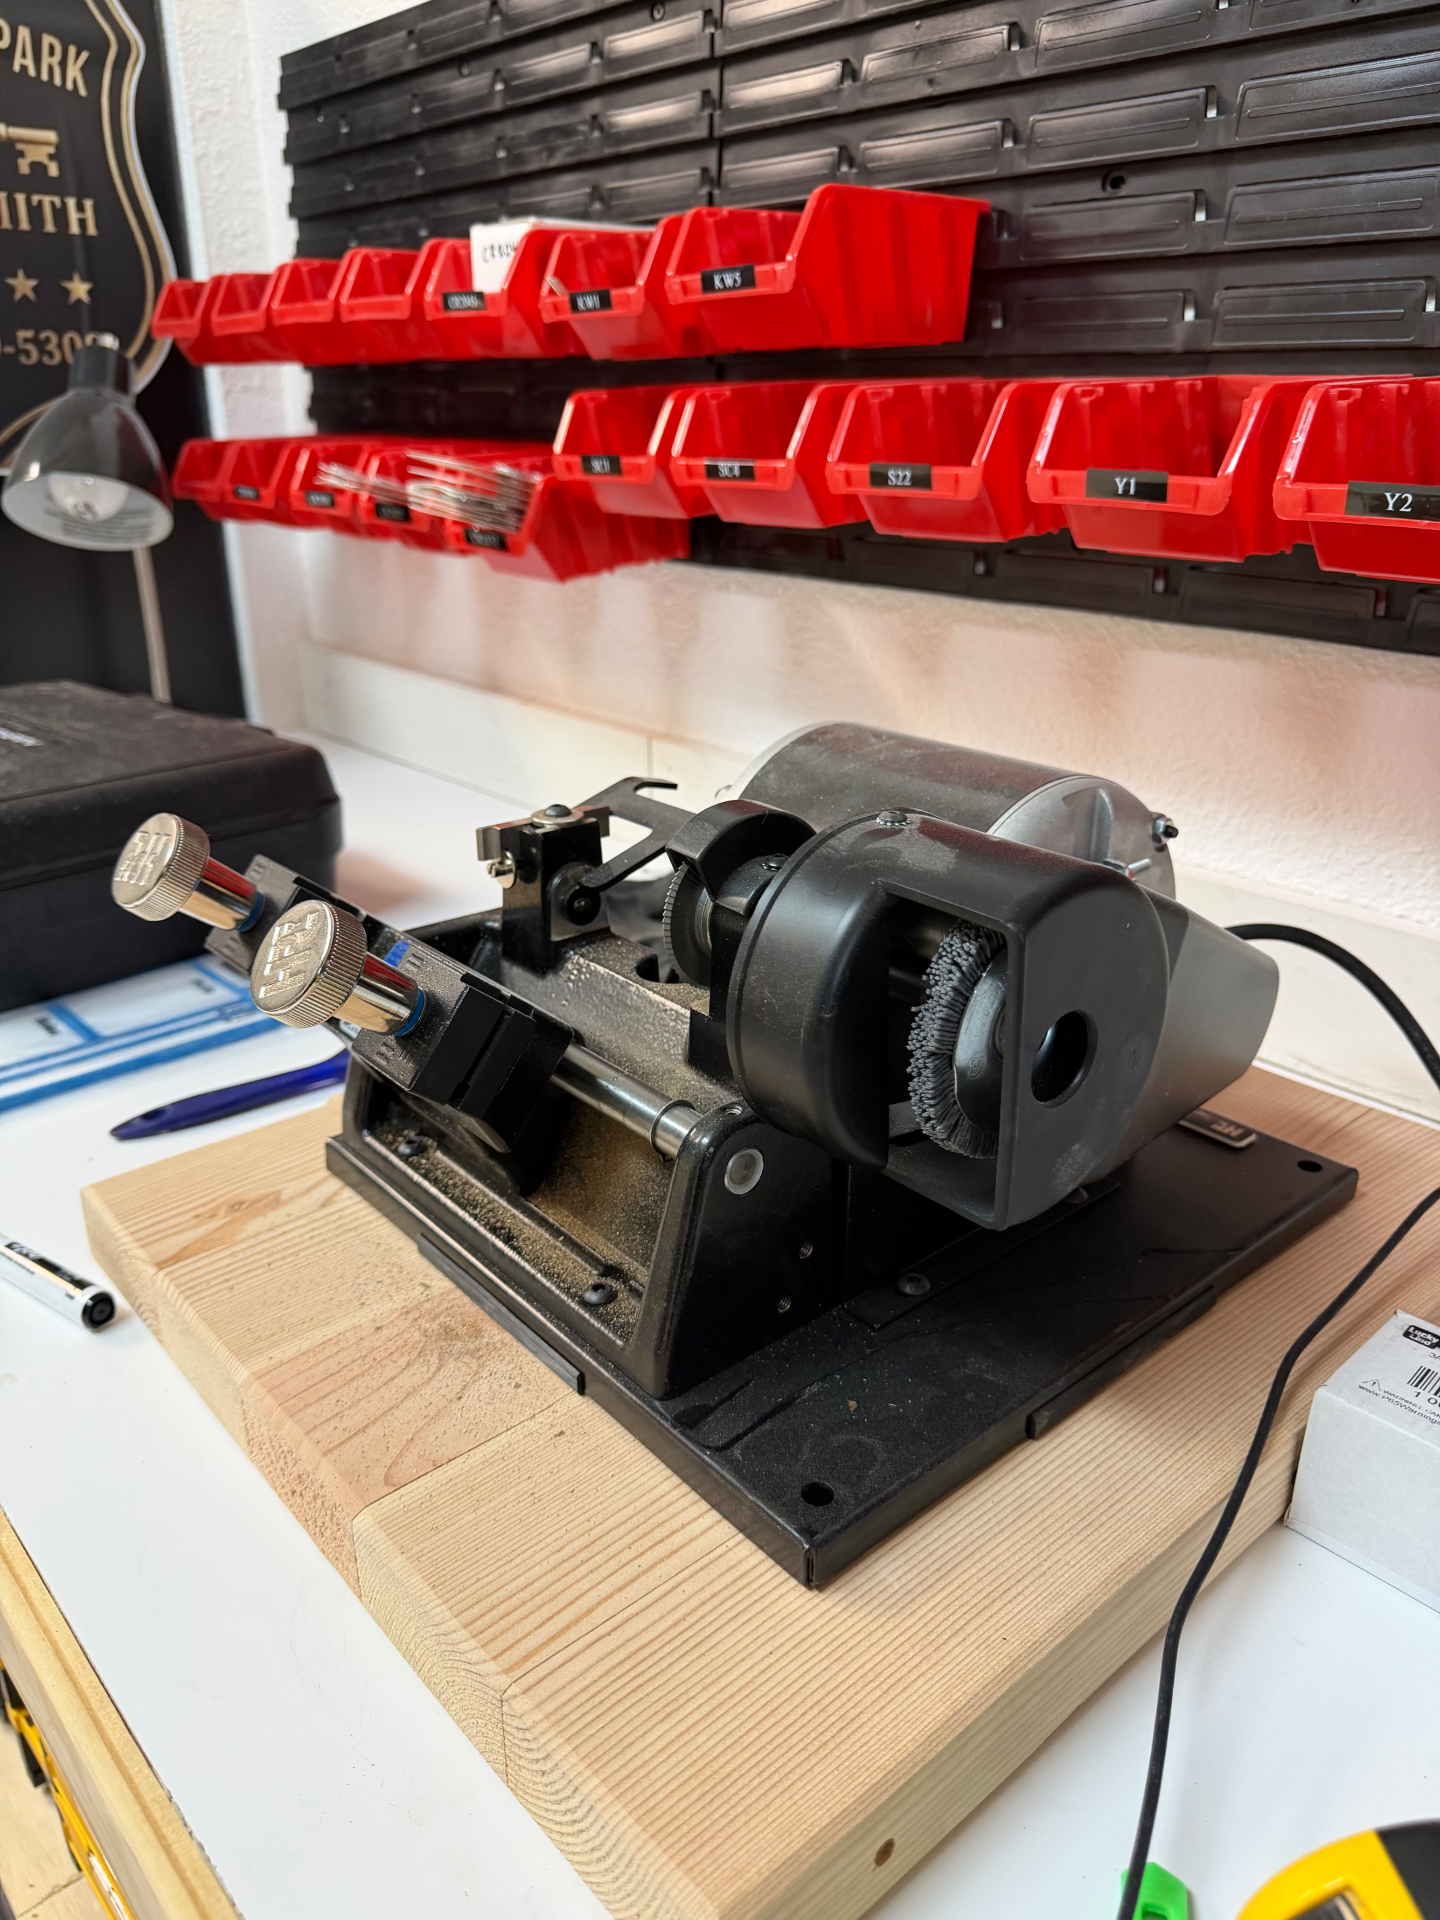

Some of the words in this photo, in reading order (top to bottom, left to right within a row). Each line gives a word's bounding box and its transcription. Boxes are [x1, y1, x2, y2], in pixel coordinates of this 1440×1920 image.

[713, 270, 742, 290] KW5
[886, 468, 912, 487] S22
[1114, 476, 1137, 495] Y1
[1384, 492, 1413, 513] Y2
